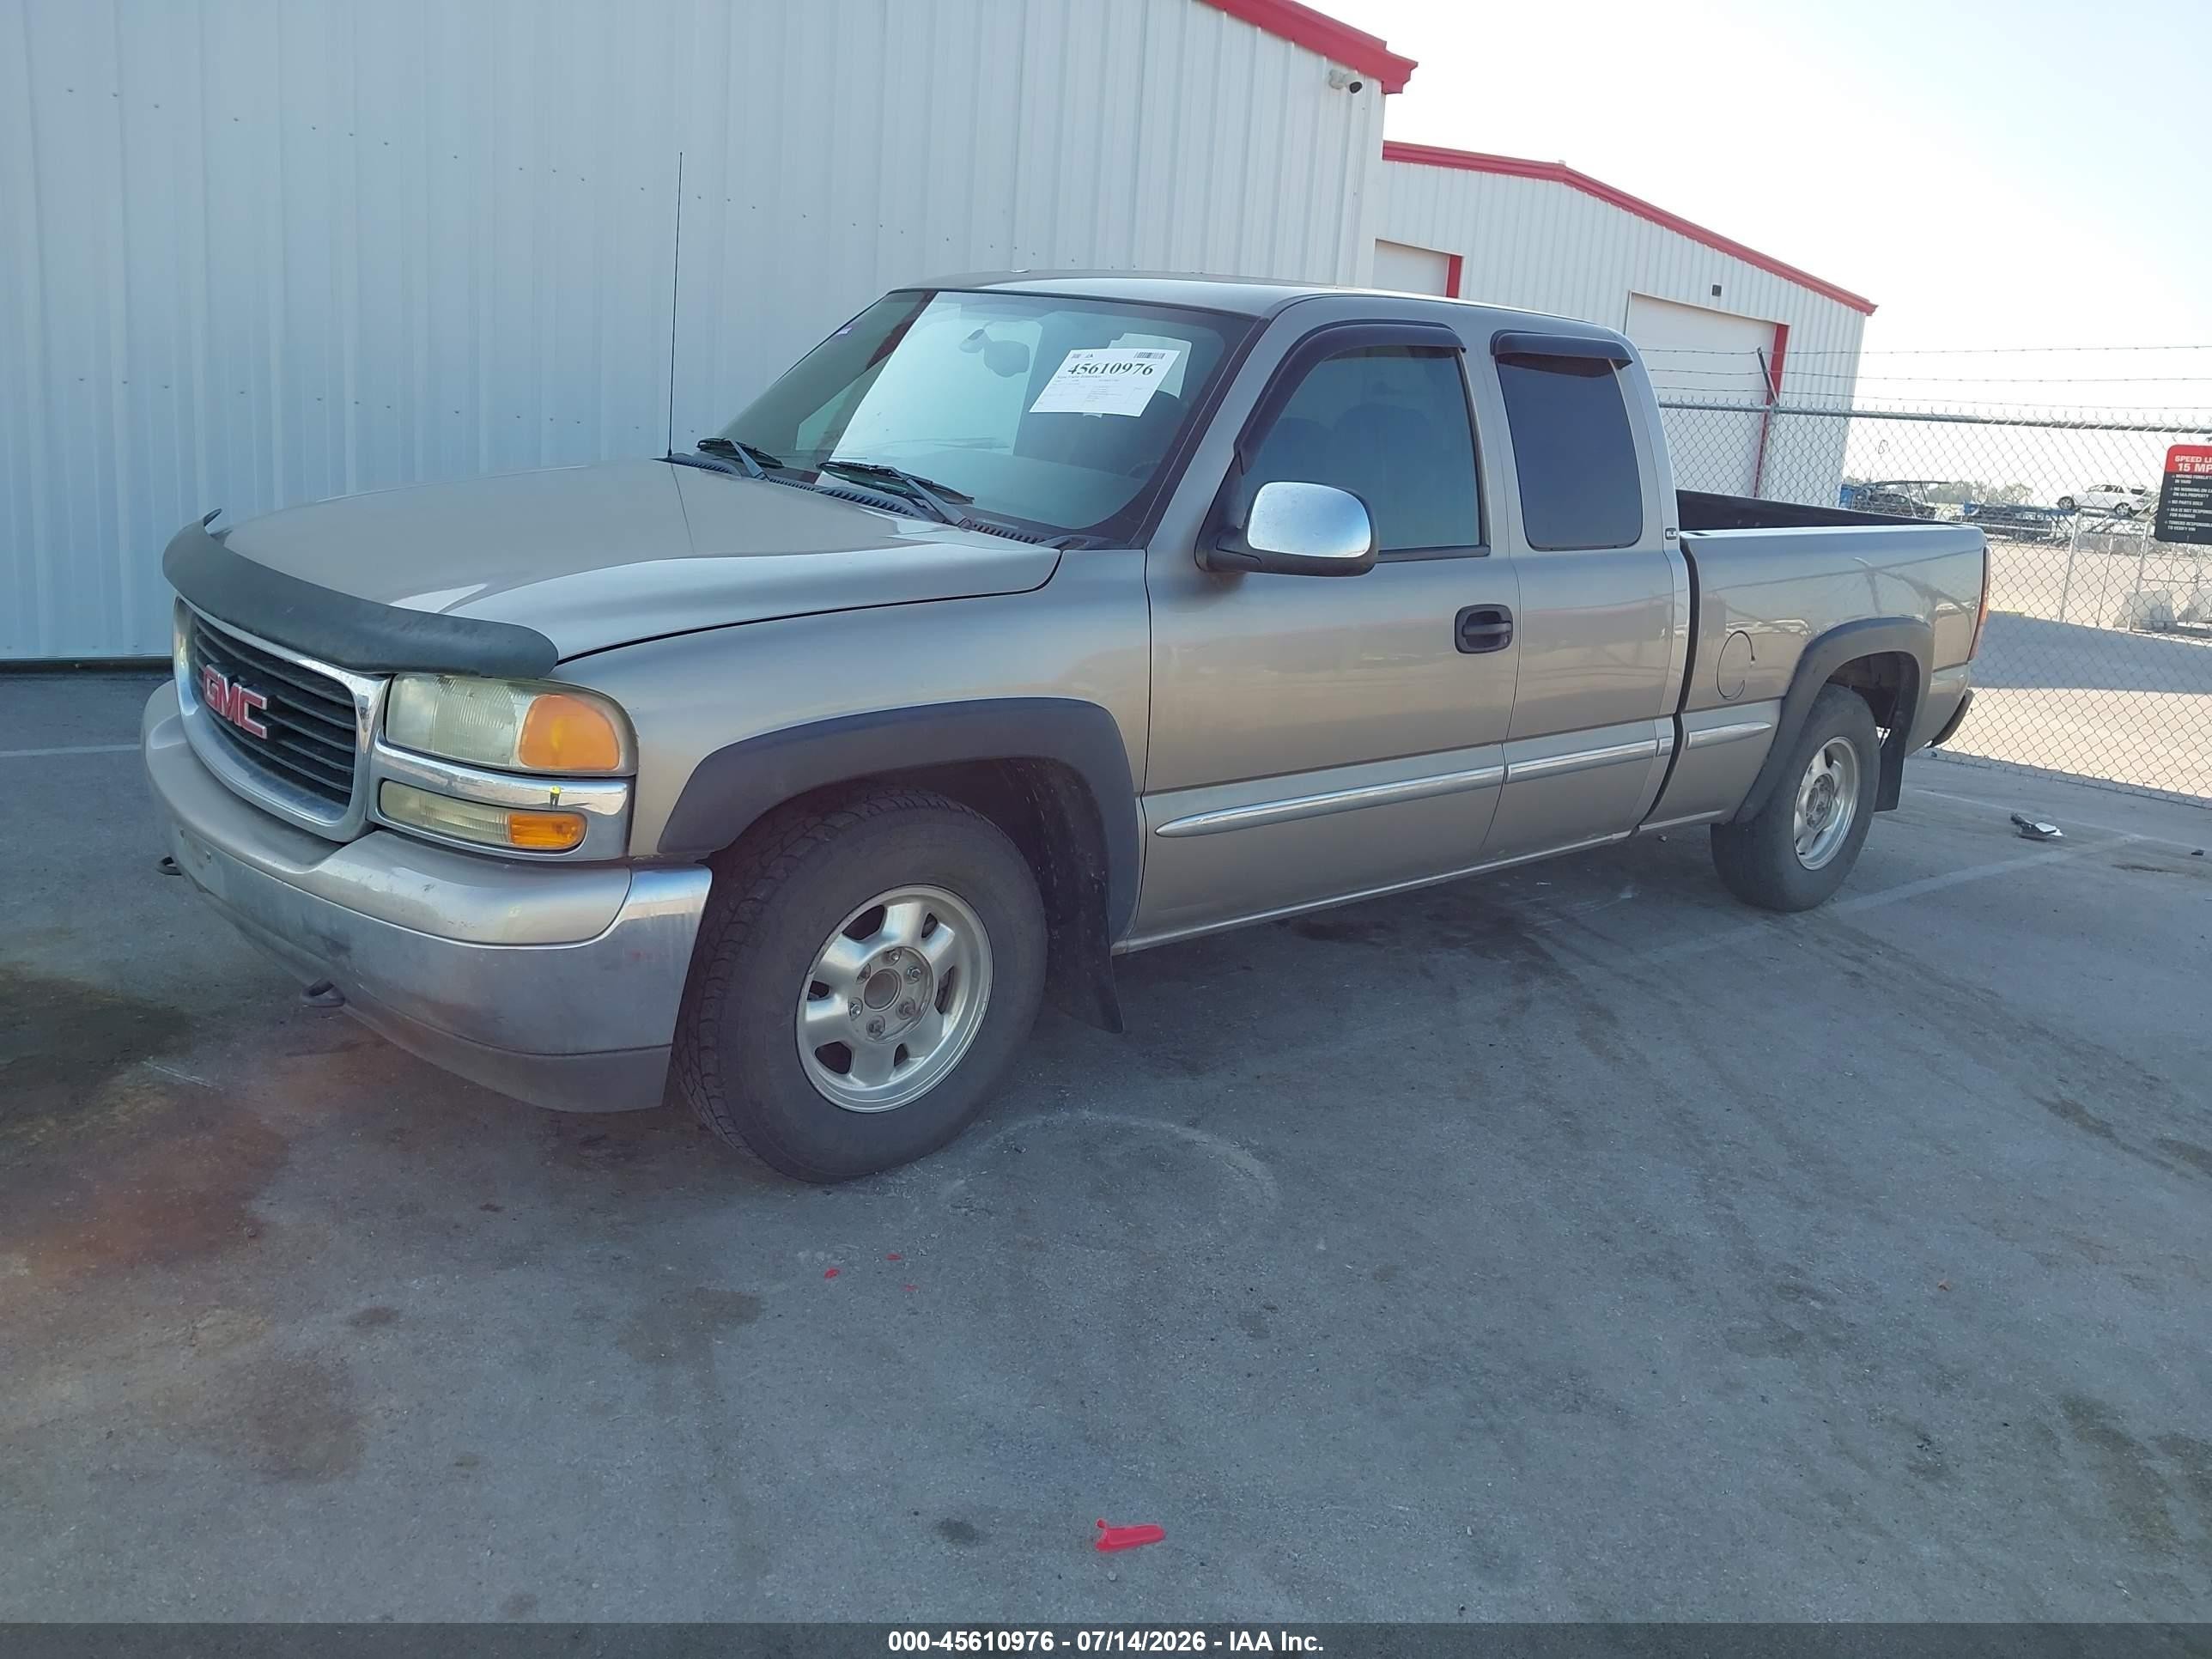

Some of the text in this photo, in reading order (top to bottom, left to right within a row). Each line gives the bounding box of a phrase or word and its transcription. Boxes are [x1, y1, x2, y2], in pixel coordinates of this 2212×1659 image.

[1067, 362, 1158, 376] 45610976
[2178, 463, 2191, 472] 15
[204, 664, 268, 739] GMC
